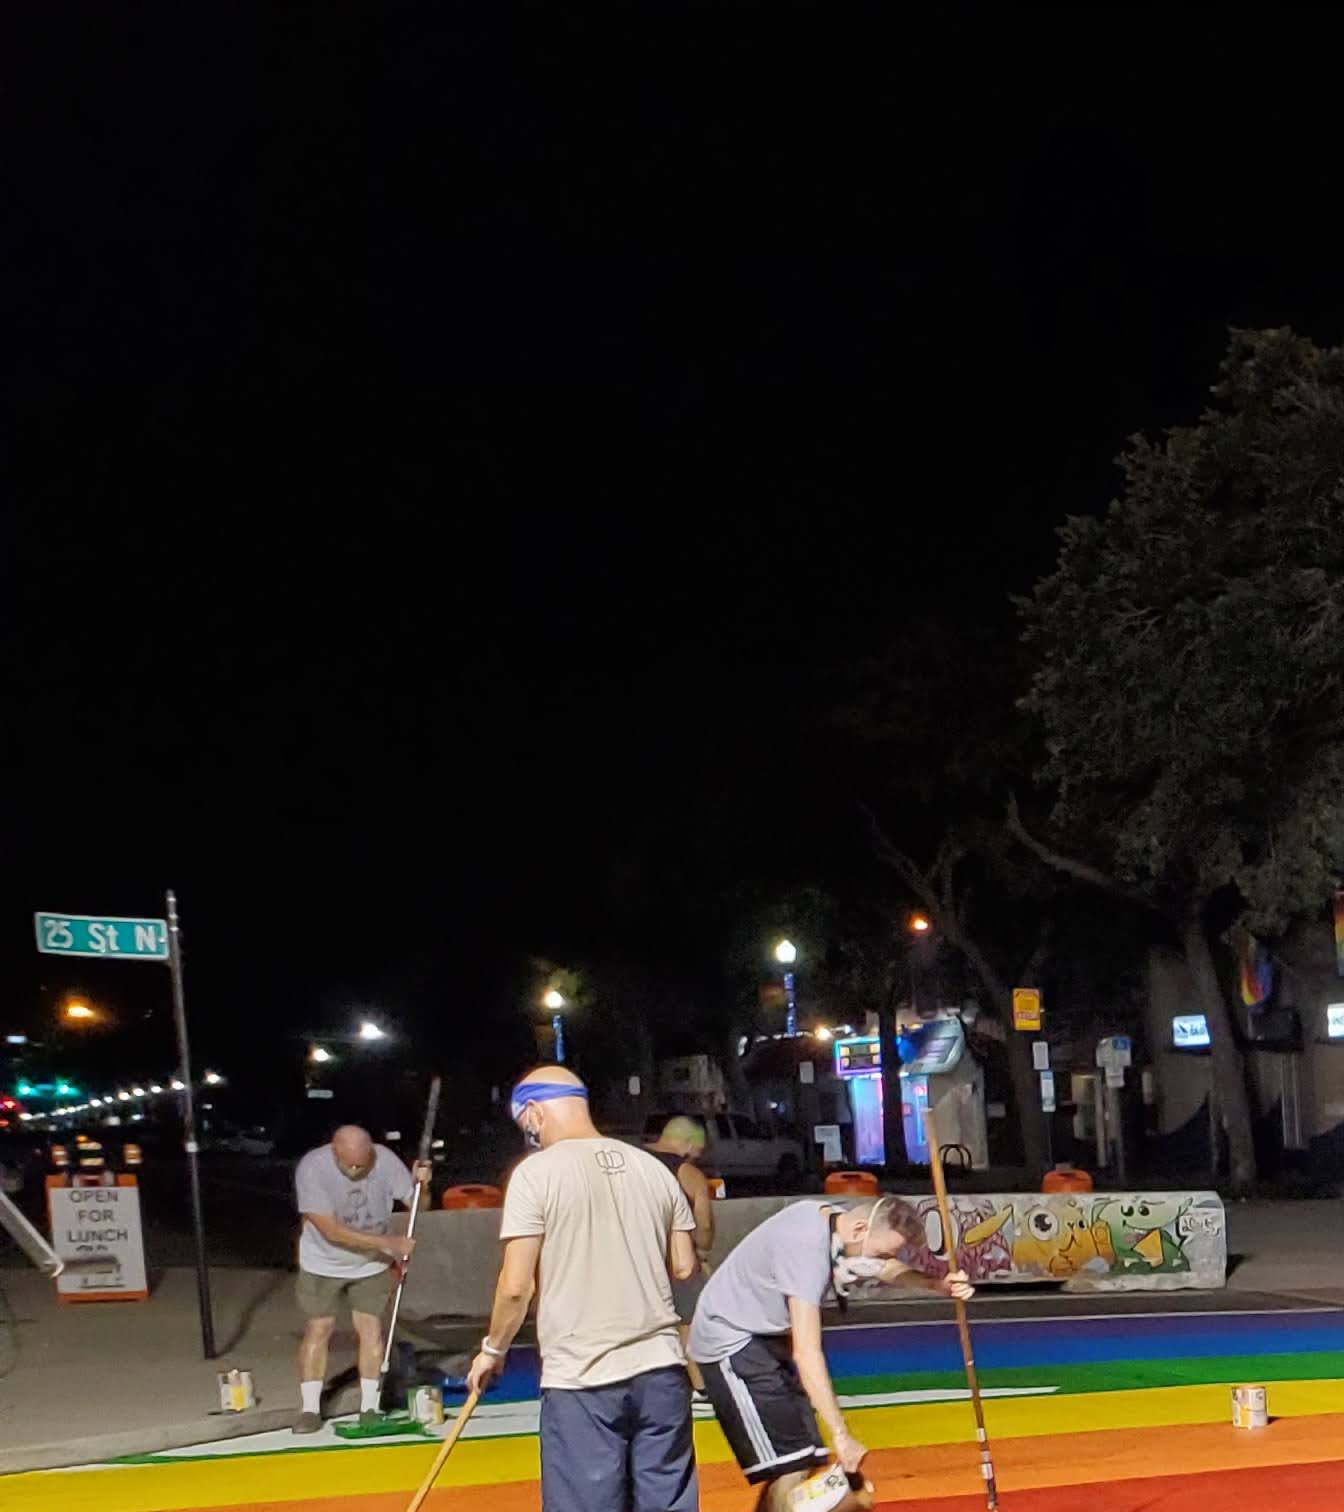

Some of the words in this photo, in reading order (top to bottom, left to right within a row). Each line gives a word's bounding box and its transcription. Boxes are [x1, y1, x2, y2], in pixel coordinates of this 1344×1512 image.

[44, 919, 74, 949] 25
[88, 922, 120, 952] St
[134, 924, 158, 952] N
[69, 1189, 119, 1203] OPEN
[78, 1208, 115, 1222] FOR
[67, 1228, 129, 1243] LUNCH
